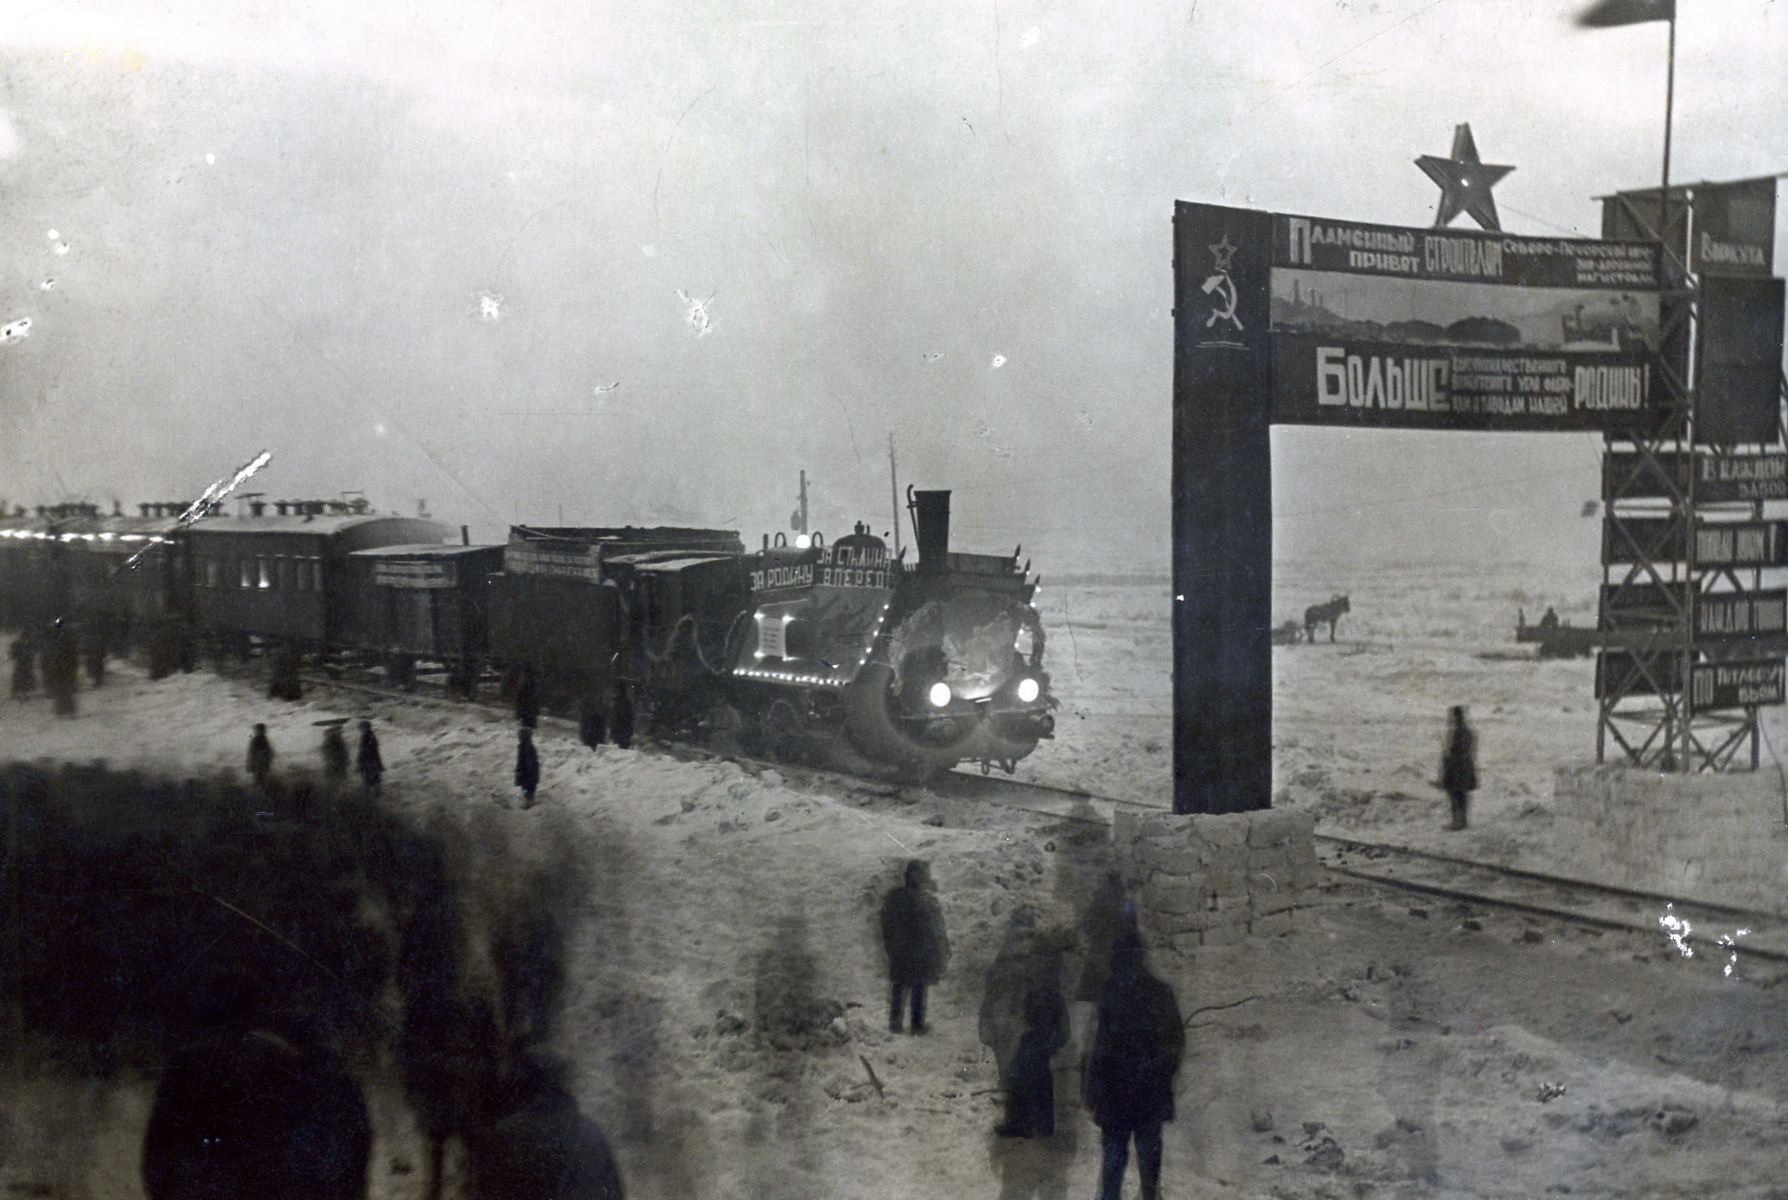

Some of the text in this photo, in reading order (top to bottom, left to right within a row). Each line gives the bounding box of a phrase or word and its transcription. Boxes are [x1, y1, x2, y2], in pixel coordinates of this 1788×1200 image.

[1350, 249, 1420, 273] ПРИВЕТ
[750, 564, 814, 592] ЗА РОДИНУ
